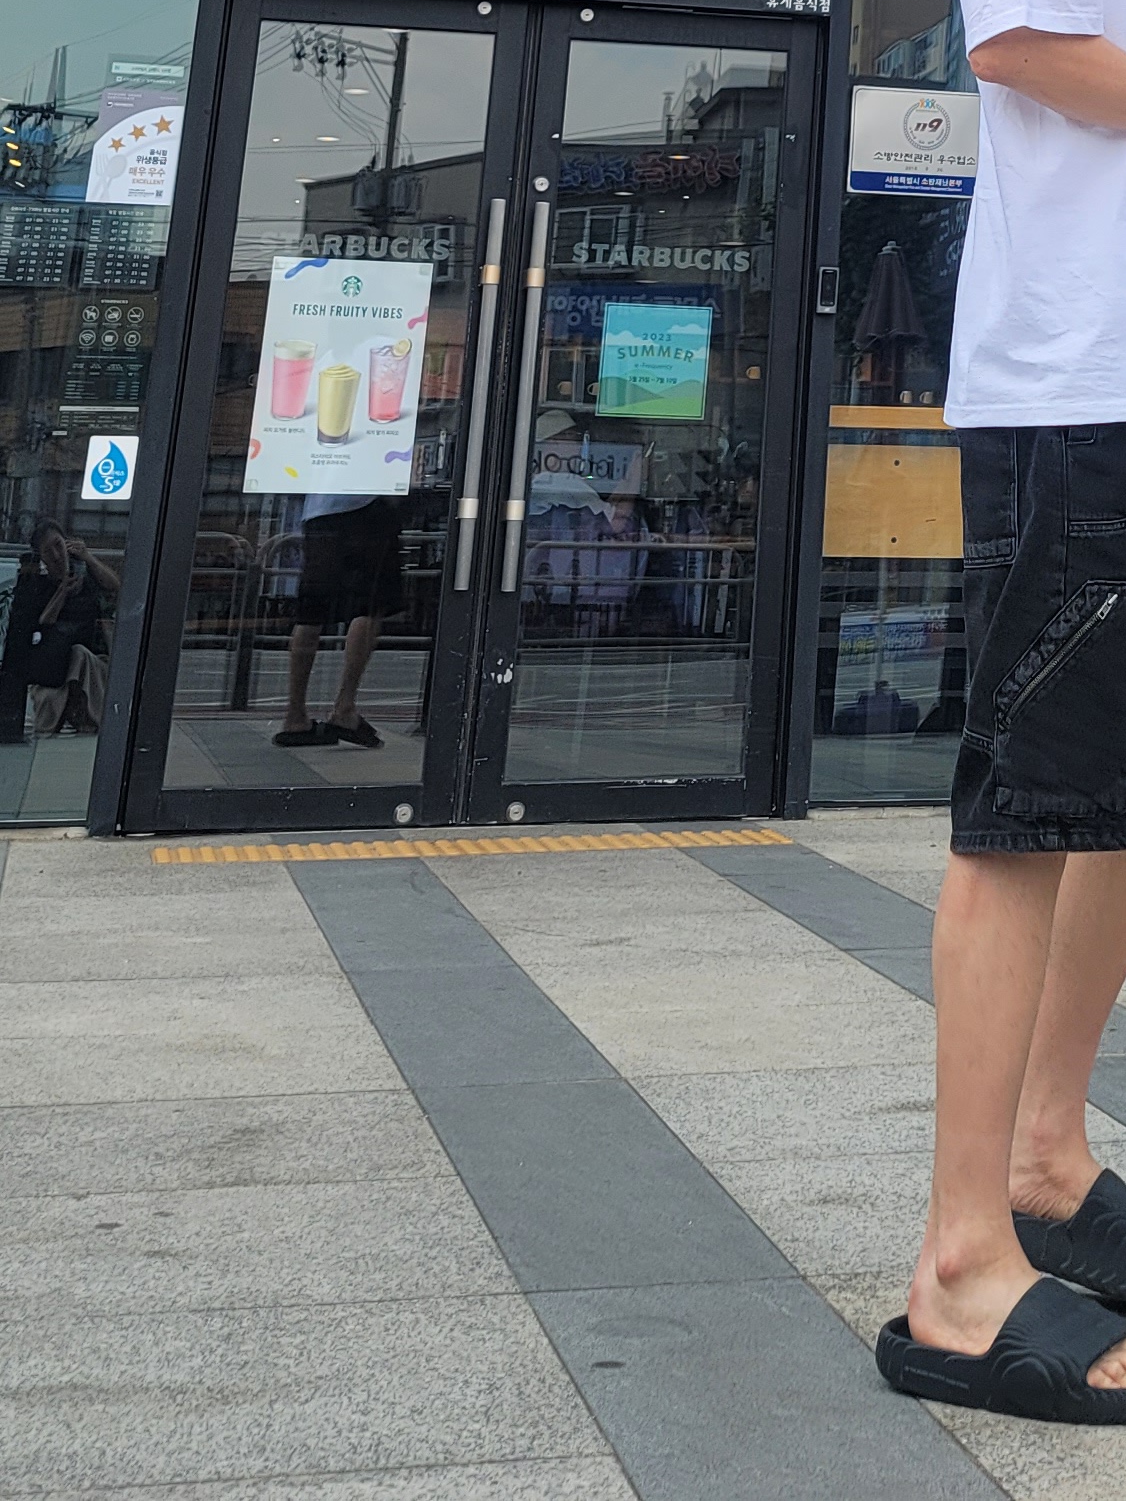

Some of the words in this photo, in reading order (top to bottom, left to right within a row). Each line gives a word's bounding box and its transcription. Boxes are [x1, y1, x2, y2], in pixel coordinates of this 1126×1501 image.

[136, 155, 167, 165] 위생등급
[873, 151, 933, 164] 소방안전관리
[936, 154, 977, 166] 우수업소
[129, 166, 147, 177] 매우
[148, 167, 166, 178] 우수
[885, 176, 920, 185] 서울특별시
[921, 177, 963, 187] 소방재난본부
[573, 241, 751, 273] STARBUCKS
[293, 303, 326, 317] FRESH
[330, 305, 368, 318] FRUITY
[371, 306, 403, 319] VIBES
[642, 333, 673, 342] 2023
[617, 345, 695, 363] SUMMER
